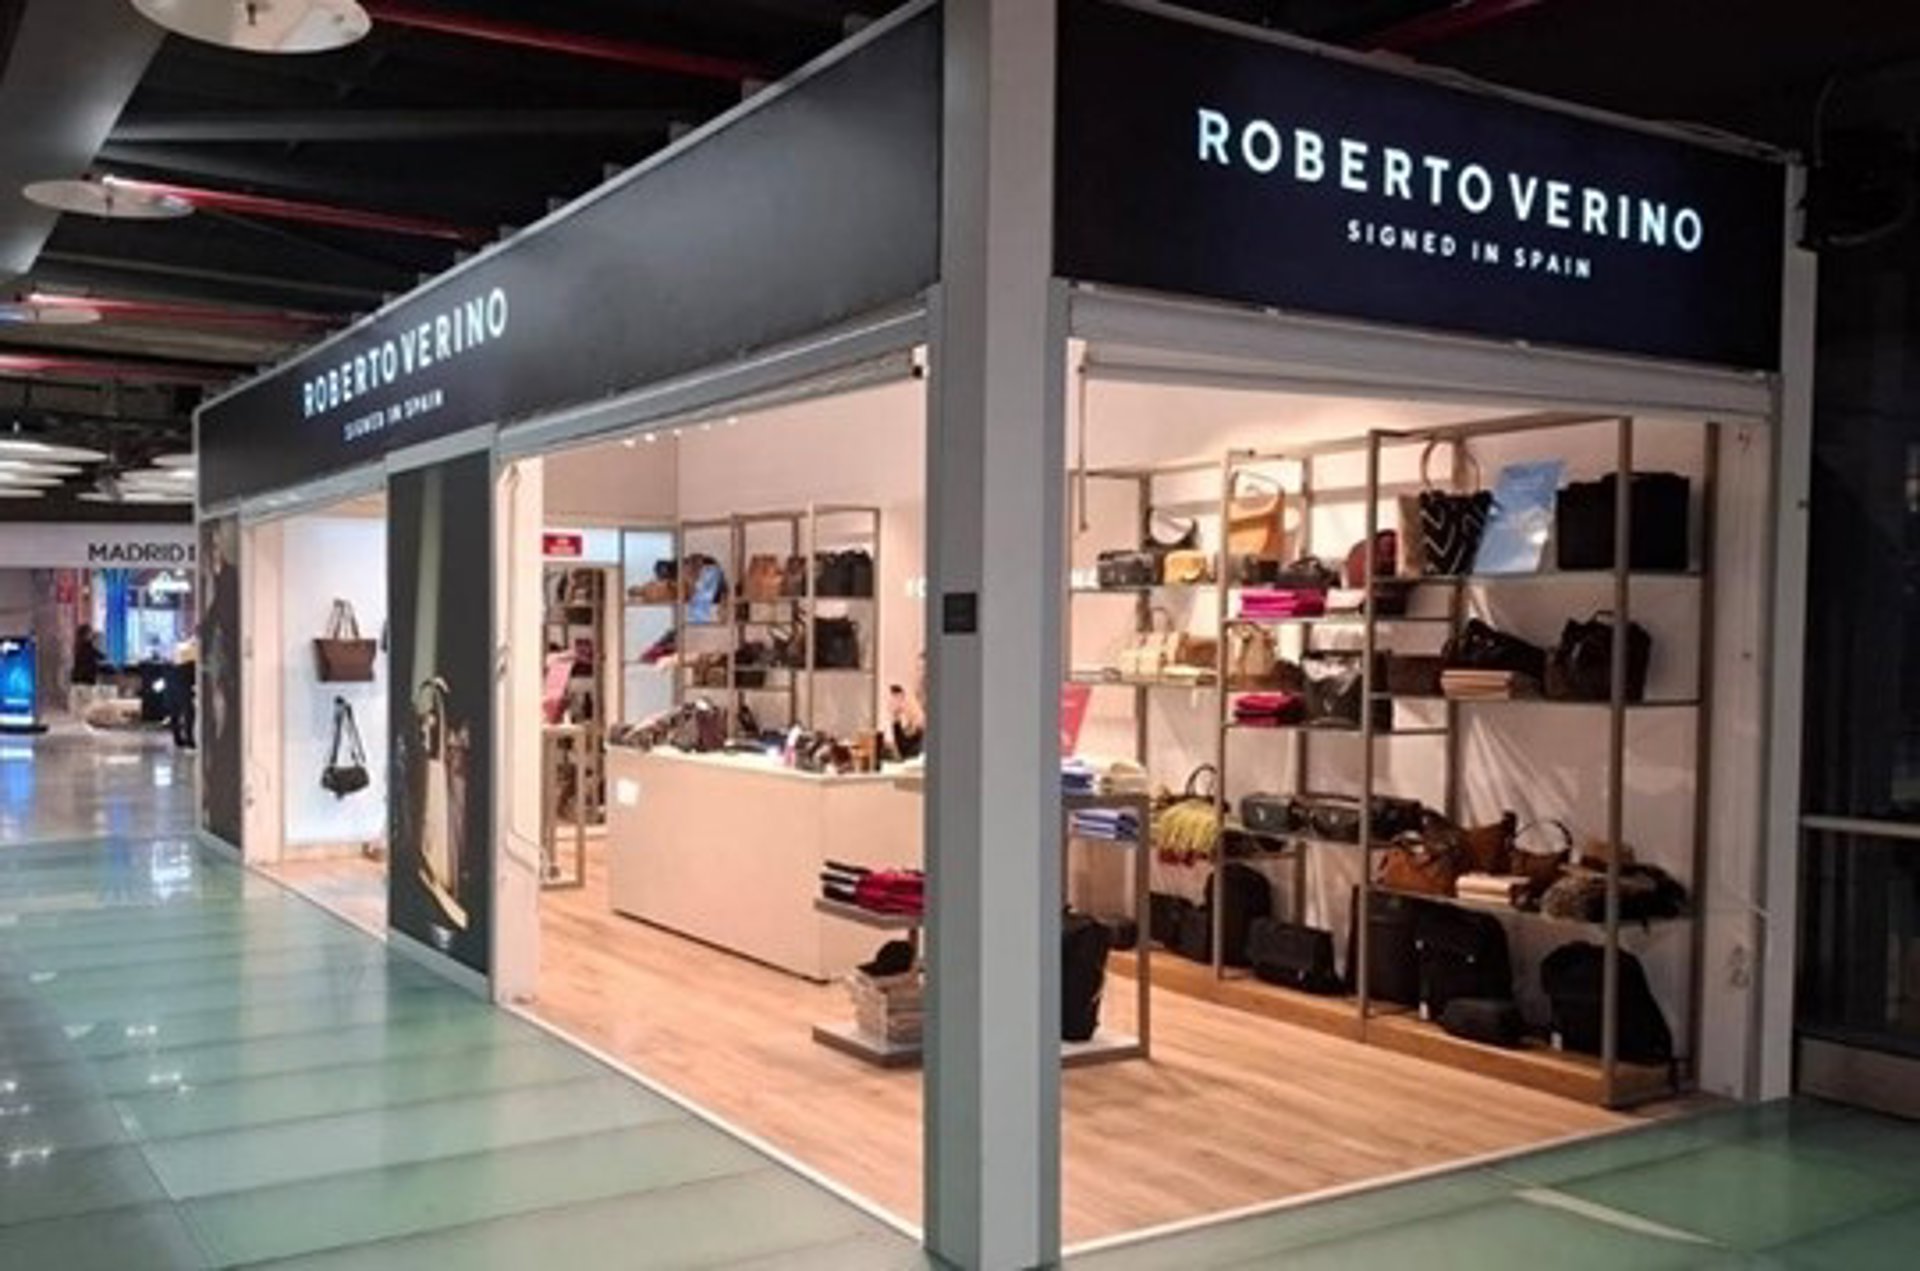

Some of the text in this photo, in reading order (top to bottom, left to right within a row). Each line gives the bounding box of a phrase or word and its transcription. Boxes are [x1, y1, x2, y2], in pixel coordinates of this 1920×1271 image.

[1198, 108, 1703, 251] ROBERTO VERINO
[1347, 218, 1593, 279] SIGNED IN SPAIN
[304, 286, 509, 420] ROBERTO VERINO
